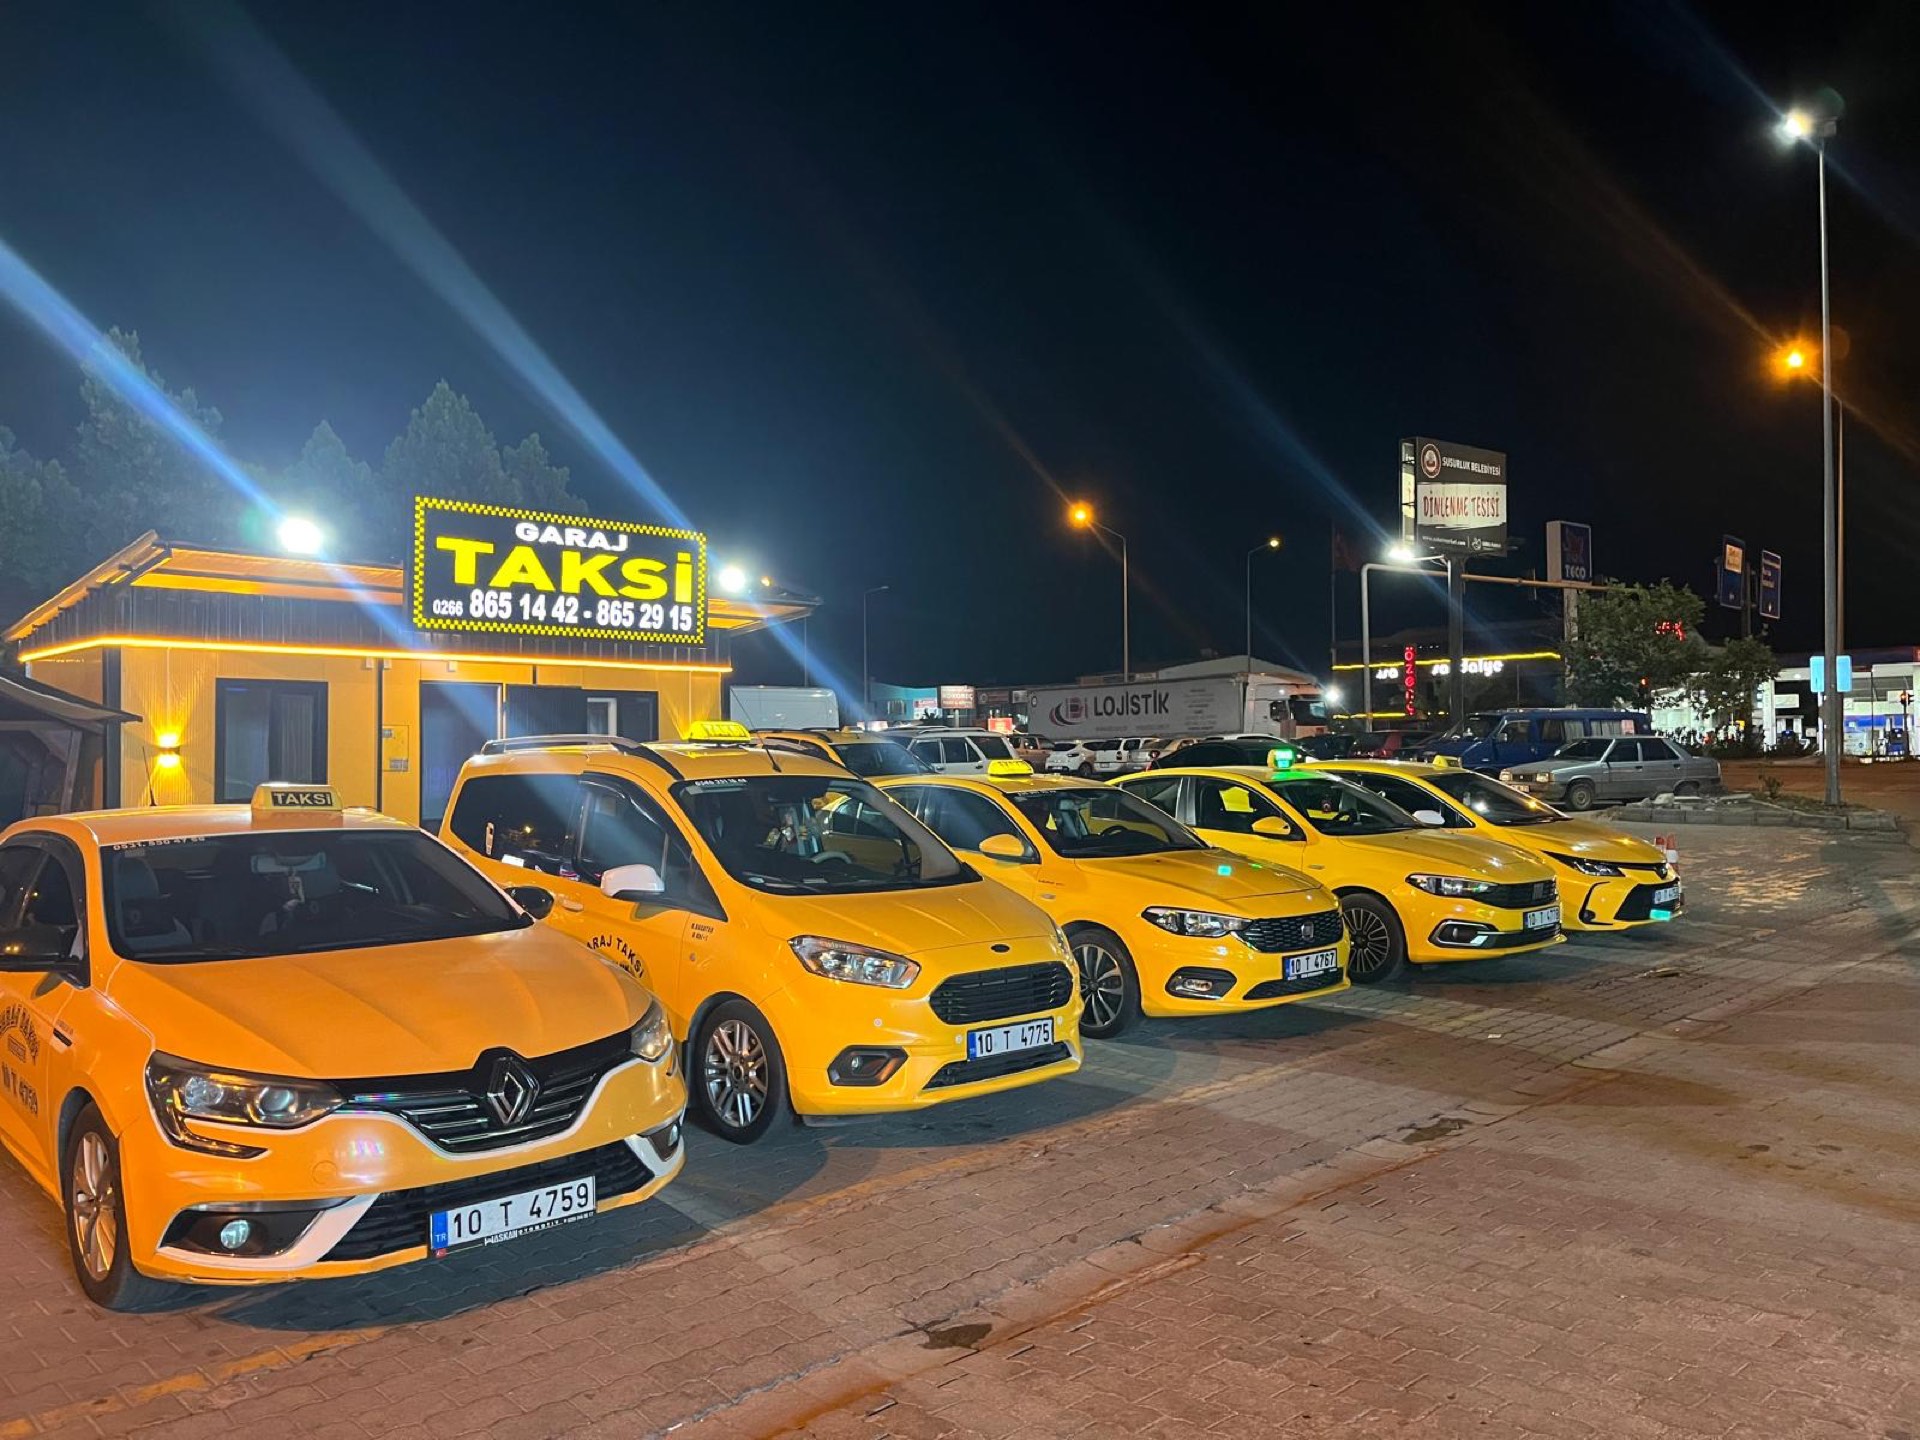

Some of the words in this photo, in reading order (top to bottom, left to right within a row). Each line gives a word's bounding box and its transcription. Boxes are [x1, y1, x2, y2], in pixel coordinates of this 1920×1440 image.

[1423, 490, 1468, 517] DİNLENME
[1471, 491, 1499, 518] TESİSİ
[515, 522, 629, 552] GARAJ
[432, 598, 463, 616] 0266
[469, 588, 512, 619] 865
[519, 593, 546, 622] 14
[551, 595, 579, 624] 42
[596, 599, 635, 628] 865
[638, 602, 664, 630] 29
[669, 604, 693, 631] 15
[1094, 689, 1170, 717] LOJİSTİK
[273, 791, 332, 806] TAKSİ
[1291, 958, 1301, 974] 10
[1305, 956, 1310, 970] T
[1314, 952, 1334, 968] 4767
[978, 1033, 992, 1054] 10
[1003, 1030, 1010, 1050] T
[1021, 1023, 1050, 1046] 4775
[435, 1233, 446, 1243] TR
[453, 1209, 481, 1238] 10
[500, 1201, 513, 1226] T
[529, 1182, 589, 1218] 4759
